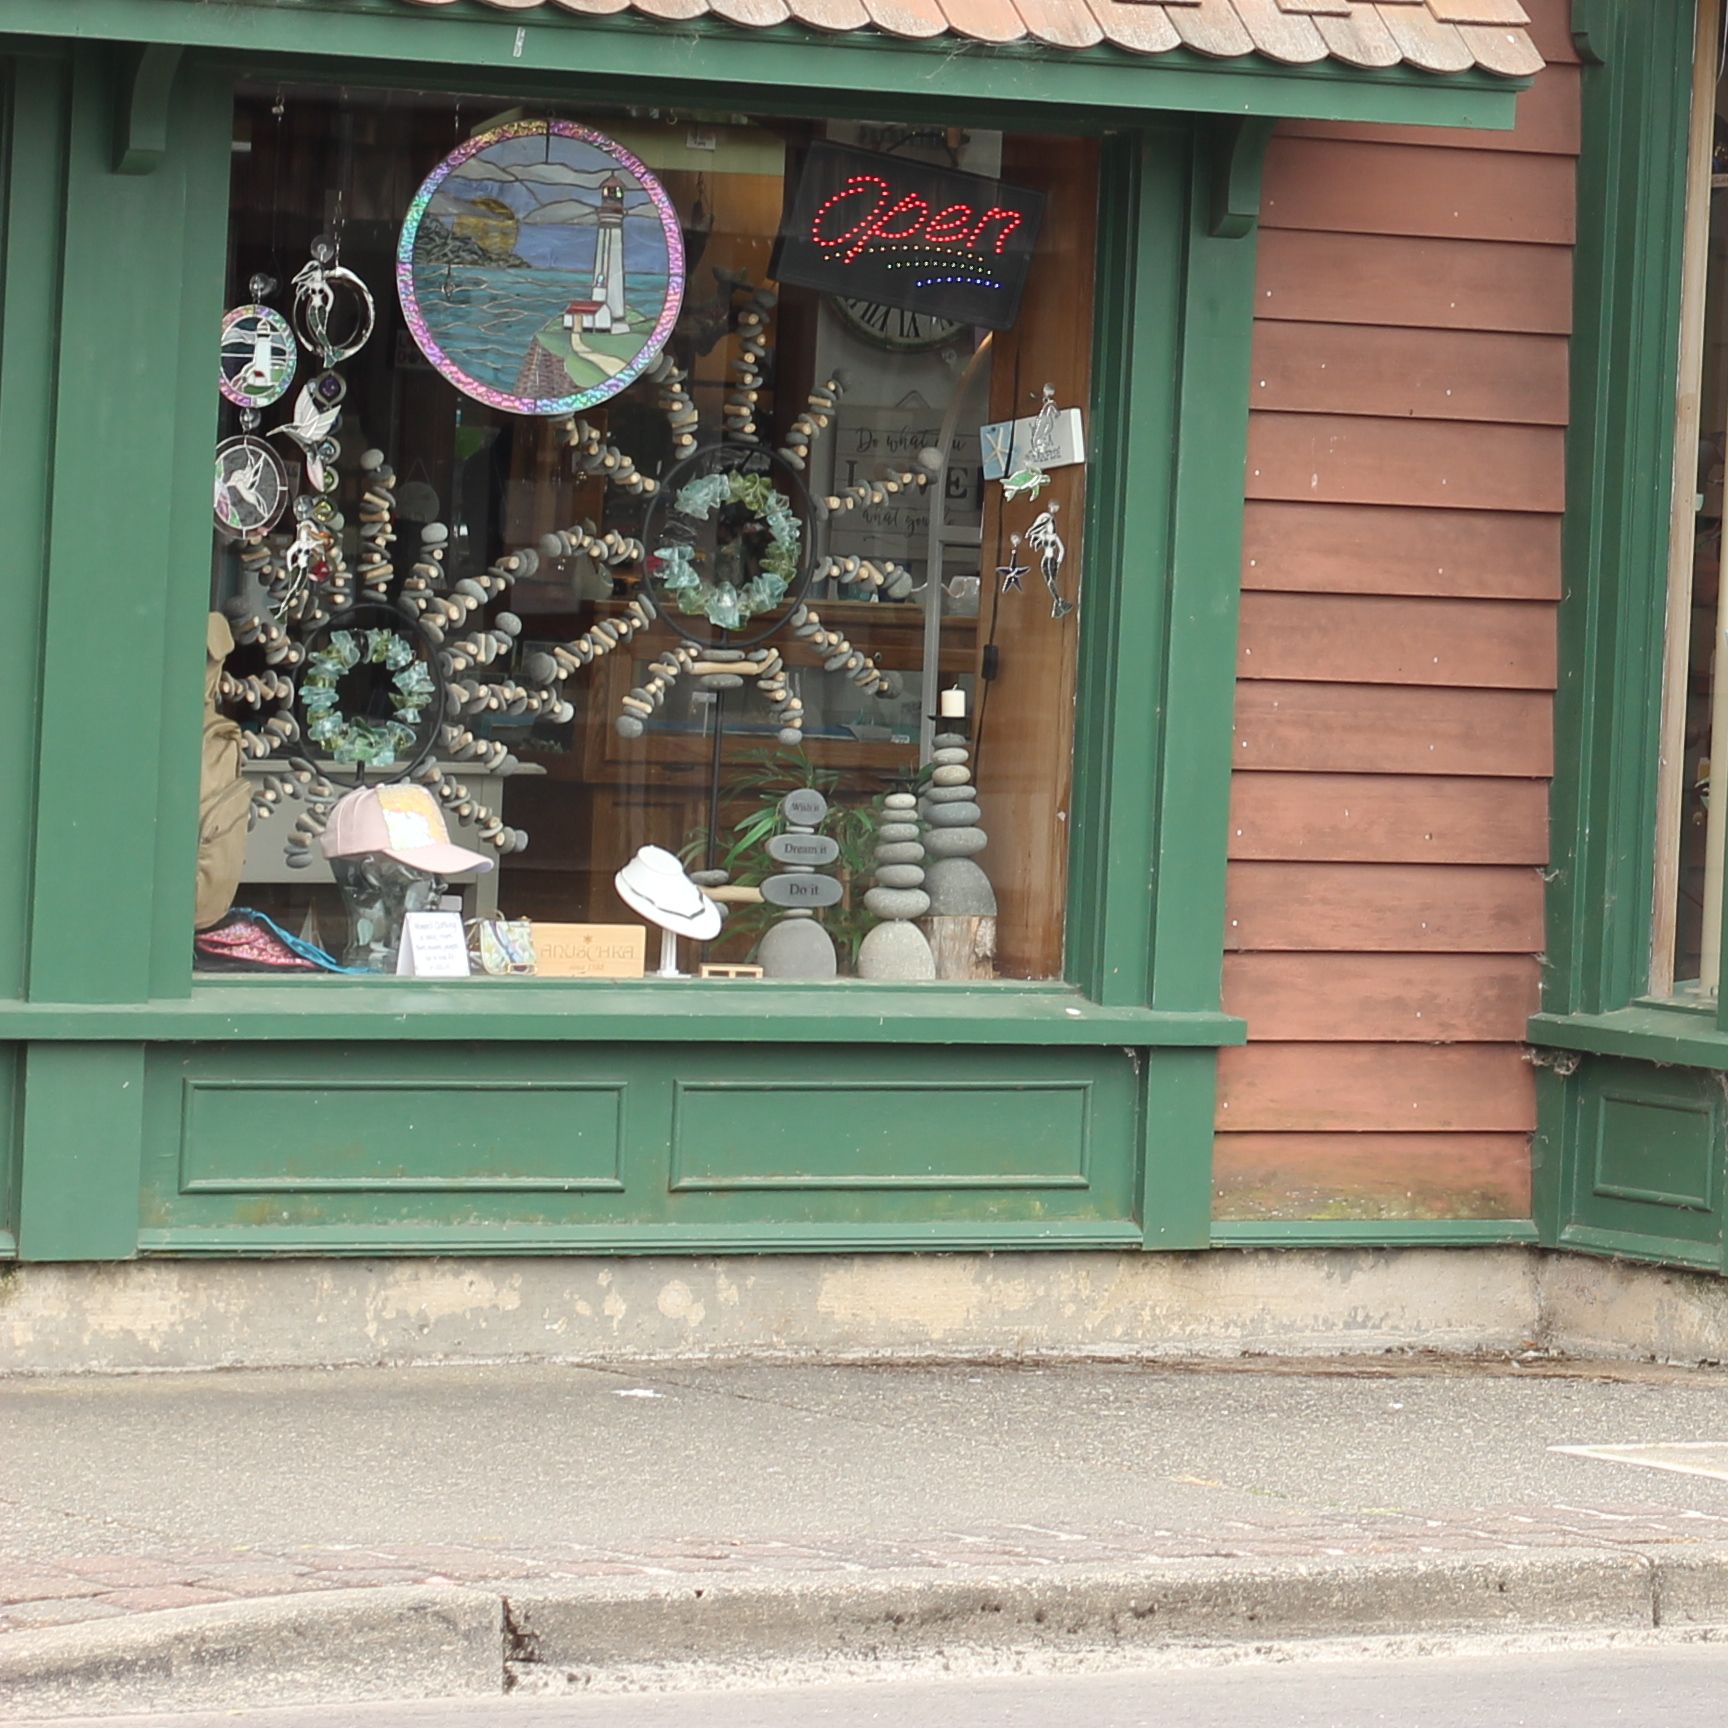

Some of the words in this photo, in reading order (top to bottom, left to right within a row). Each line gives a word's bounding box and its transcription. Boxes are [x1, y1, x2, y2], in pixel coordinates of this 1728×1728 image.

[811, 175, 1022, 264] Open
[784, 843, 817, 855] Dream
[789, 883, 807, 895] Do
[811, 884, 819, 895] it
